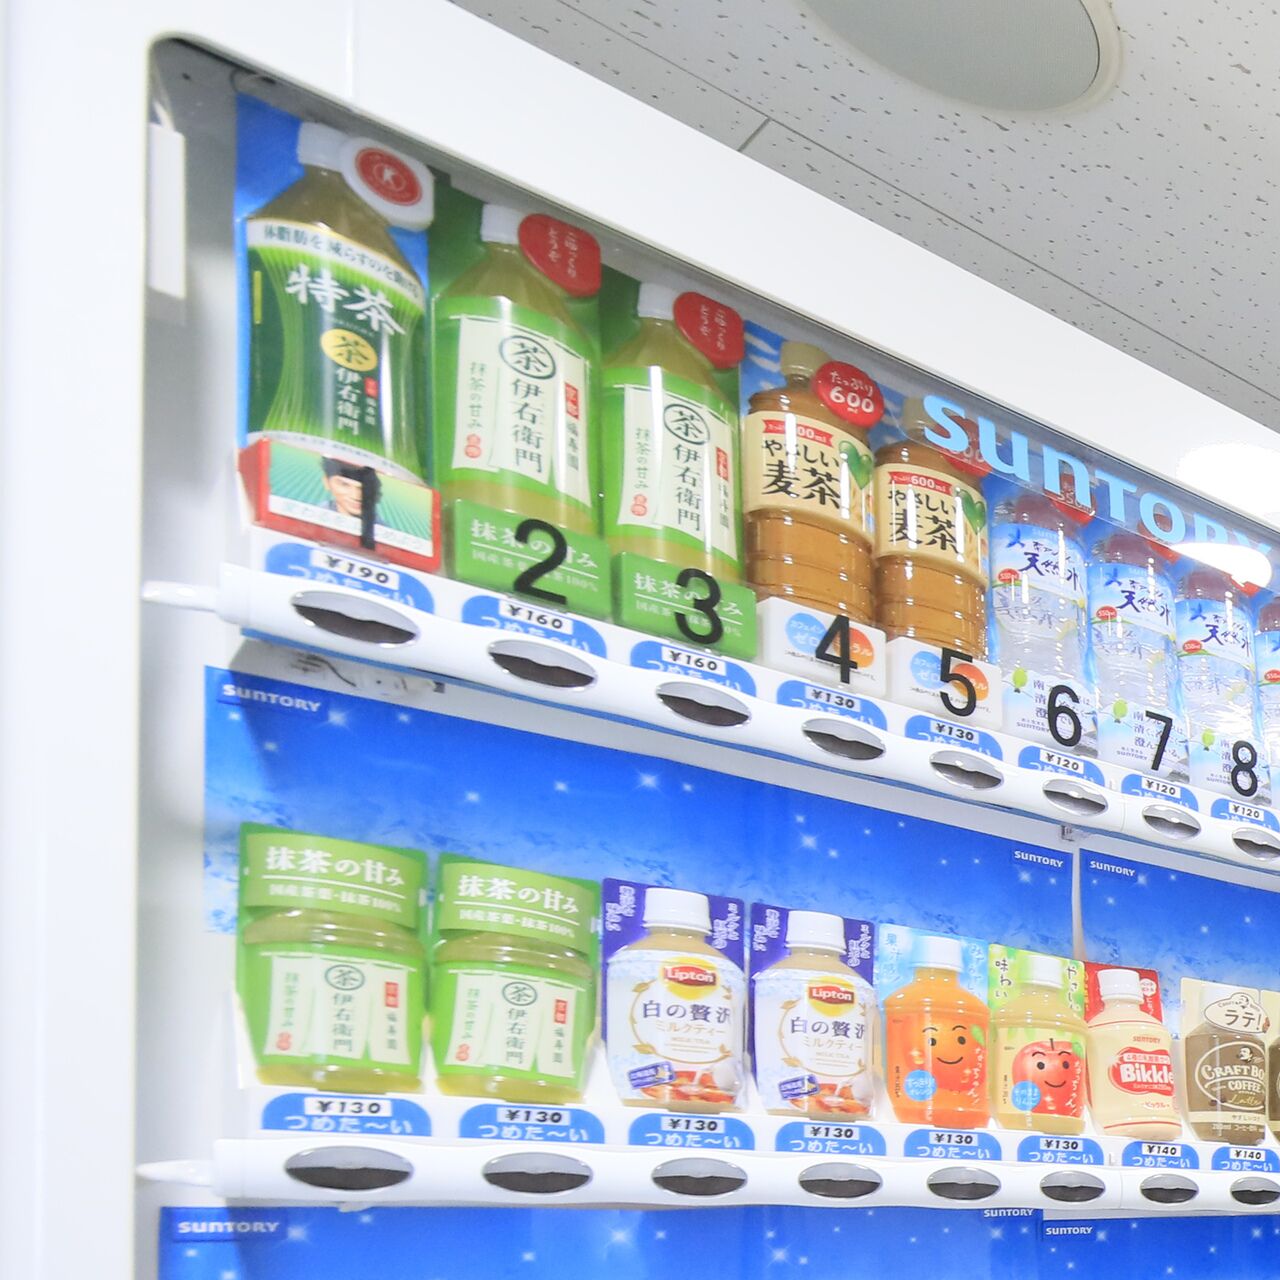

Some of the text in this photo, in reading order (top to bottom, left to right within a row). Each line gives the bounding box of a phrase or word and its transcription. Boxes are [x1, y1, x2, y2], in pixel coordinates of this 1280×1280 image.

[285, 261, 406, 336] 特茶
[512, 341, 549, 374] 茶
[829, 387, 876, 414] 600
[511, 378, 546, 475] 伊右衛門
[762, 458, 842, 510] 麦茶
[922, 394, 1272, 555] SUNTORY
[674, 443, 701, 533] 伊右衛門
[888, 511, 960, 554] 麦茶
[326, 554, 390, 584] ¥190
[513, 518, 568, 605] 2
[674, 567, 724, 644] 3
[508, 603, 564, 630] ¥160
[815, 614, 858, 684] 4
[670, 650, 718, 672] ¥160
[940, 647, 977, 717] 5
[222, 682, 322, 714] SUNTORY
[811, 688, 856, 709] ¥130
[1047, 684, 1082, 747] 6
[935, 721, 975, 741] ¥130
[1145, 710, 1173, 771] 7
[1044, 751, 1080, 772] ¥120
[1231, 740, 1258, 798] 8
[1145, 778, 1177, 797] ¥120
[1232, 803, 1261, 819] ¥120
[265, 846, 406, 887] 抹茶の甘み
[1013, 850, 1064, 867] SUNTORY
[1088, 859, 1137, 877] SUNTORY
[458, 874, 581, 914] 抹茶の甘み
[664, 966, 716, 984] Lipton
[811, 987, 853, 1002] Lipton
[1119, 1063, 1175, 1084] Bikkle
[1201, 1064, 1251, 1080] CRAFT
[315, 1099, 383, 1117] ¥130
[504, 1108, 564, 1125] ¥130
[667, 1117, 720, 1132] ¥130
[810, 1126, 855, 1139] ¥130
[934, 1132, 973, 1145] ¥130
[1043, 1138, 1079, 1151] ¥130
[1146, 1144, 1178, 1156] ¥140
[1234, 1149, 1263, 1160] ¥140
[178, 1219, 280, 1235] SUNTORY
[1045, 1225, 1094, 1236] SUNTORY
